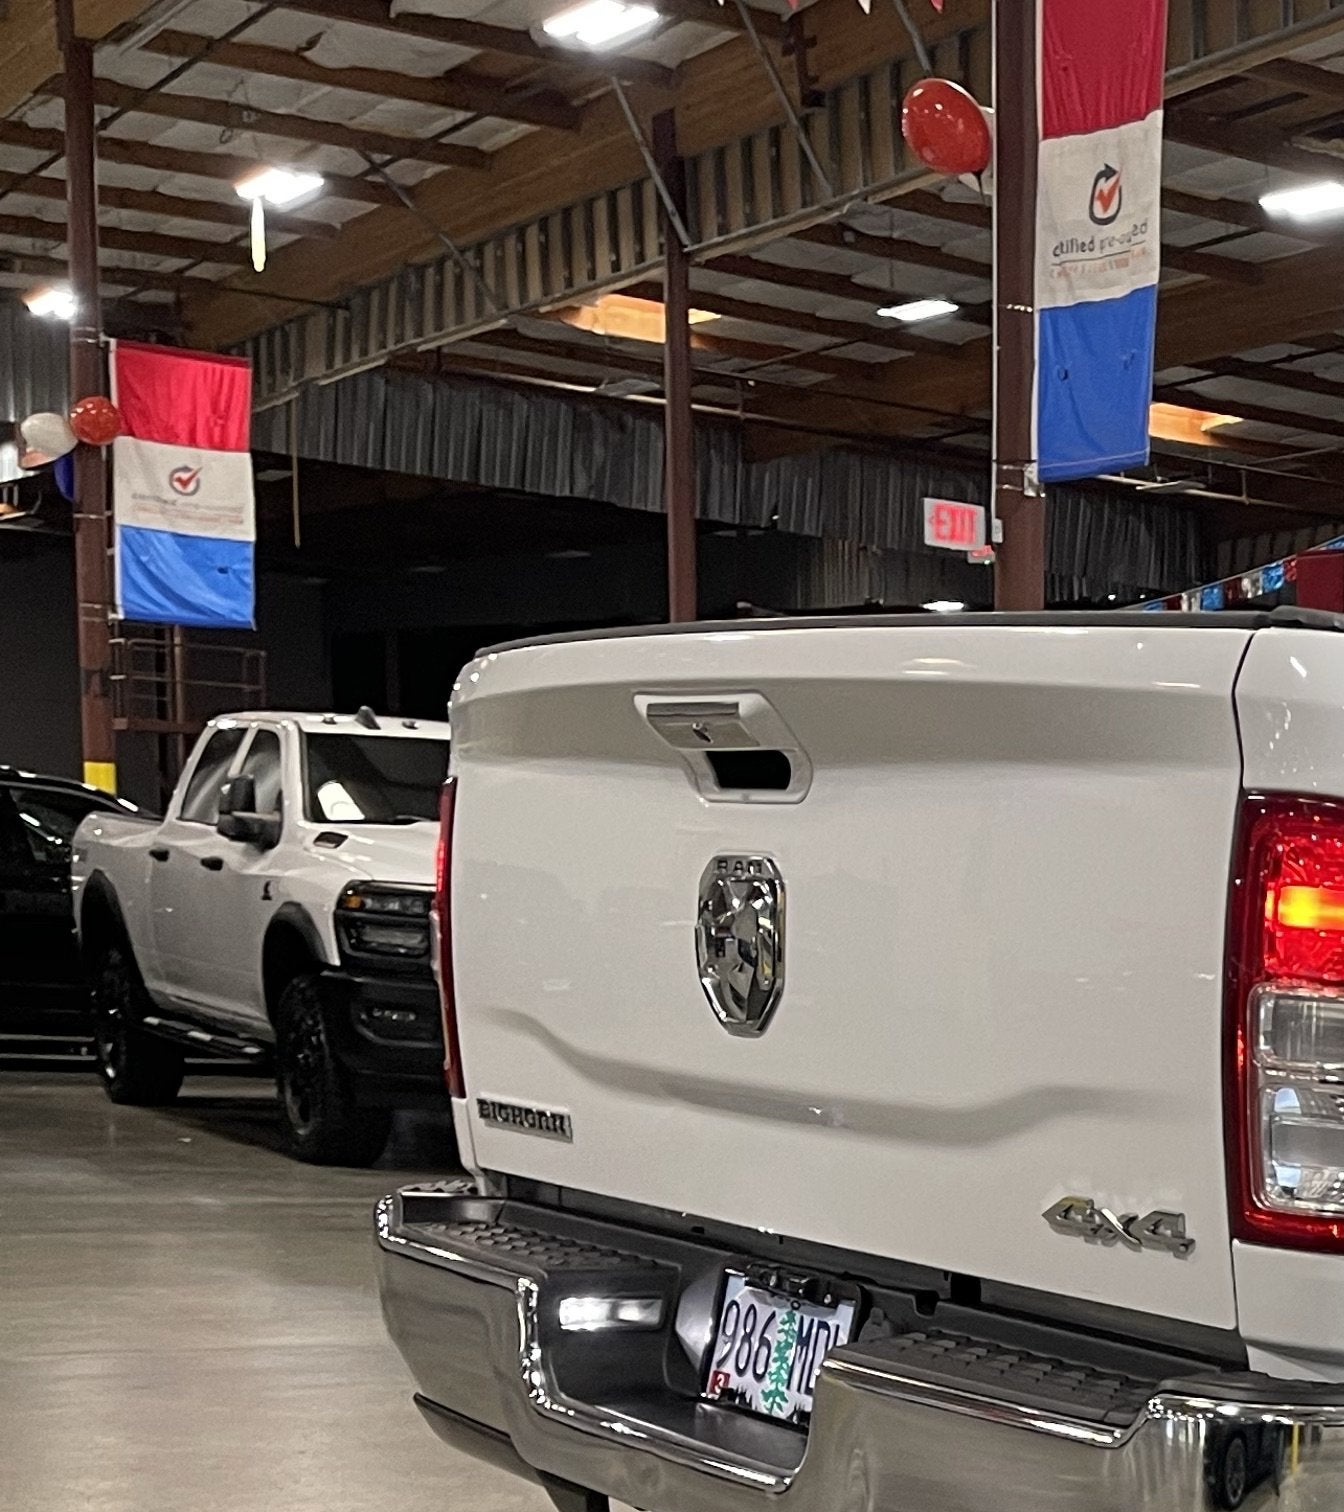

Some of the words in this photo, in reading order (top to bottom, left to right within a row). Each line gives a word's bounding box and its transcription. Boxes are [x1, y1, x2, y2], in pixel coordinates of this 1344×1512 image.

[933, 503, 976, 544] EXIT
[716, 860, 763, 875] RAM
[1041, 1196, 1196, 1260] 4x4
[716, 1299, 777, 1383] 986
